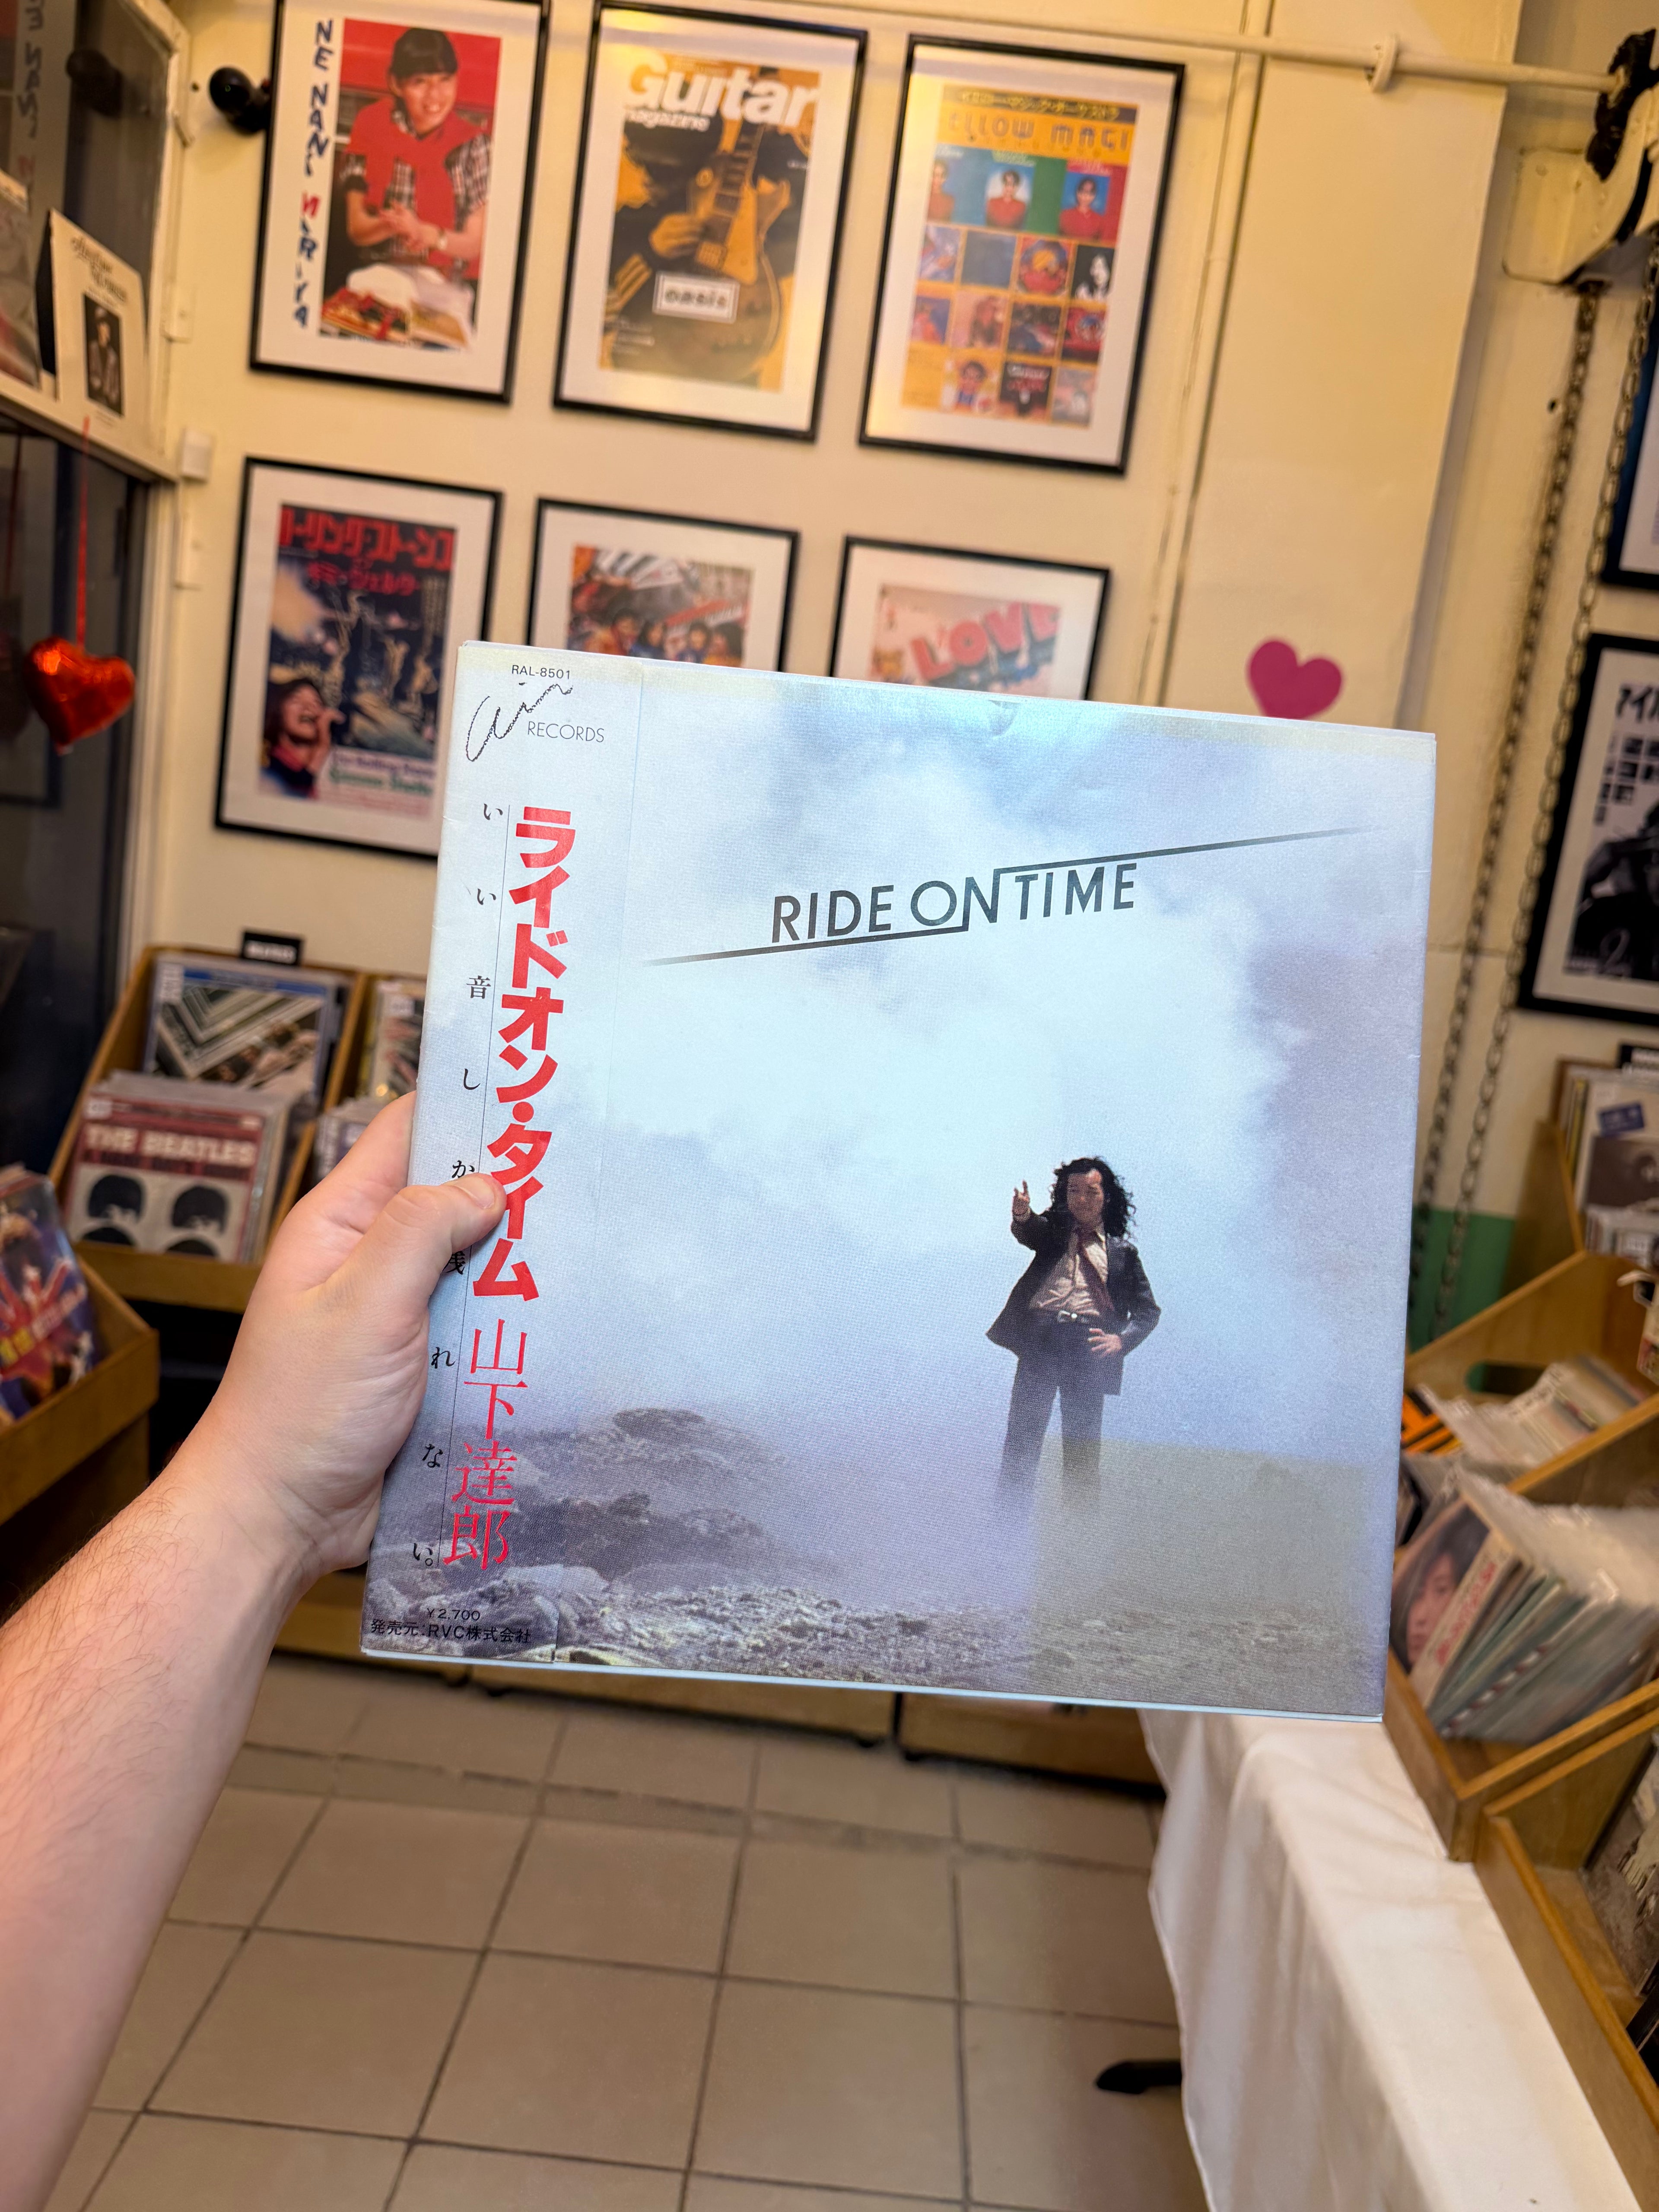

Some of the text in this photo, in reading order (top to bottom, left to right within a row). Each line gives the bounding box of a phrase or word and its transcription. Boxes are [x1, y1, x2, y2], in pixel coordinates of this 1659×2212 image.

[624, 51, 822, 128] Guitar
[511, 664, 571, 680] RAL-8501
[528, 721, 605, 743] RECORDS
[772, 862, 1137, 943] RIDE ON TIME
[442, 805, 576, 1571] ライドオン・タイム 山下達郎
